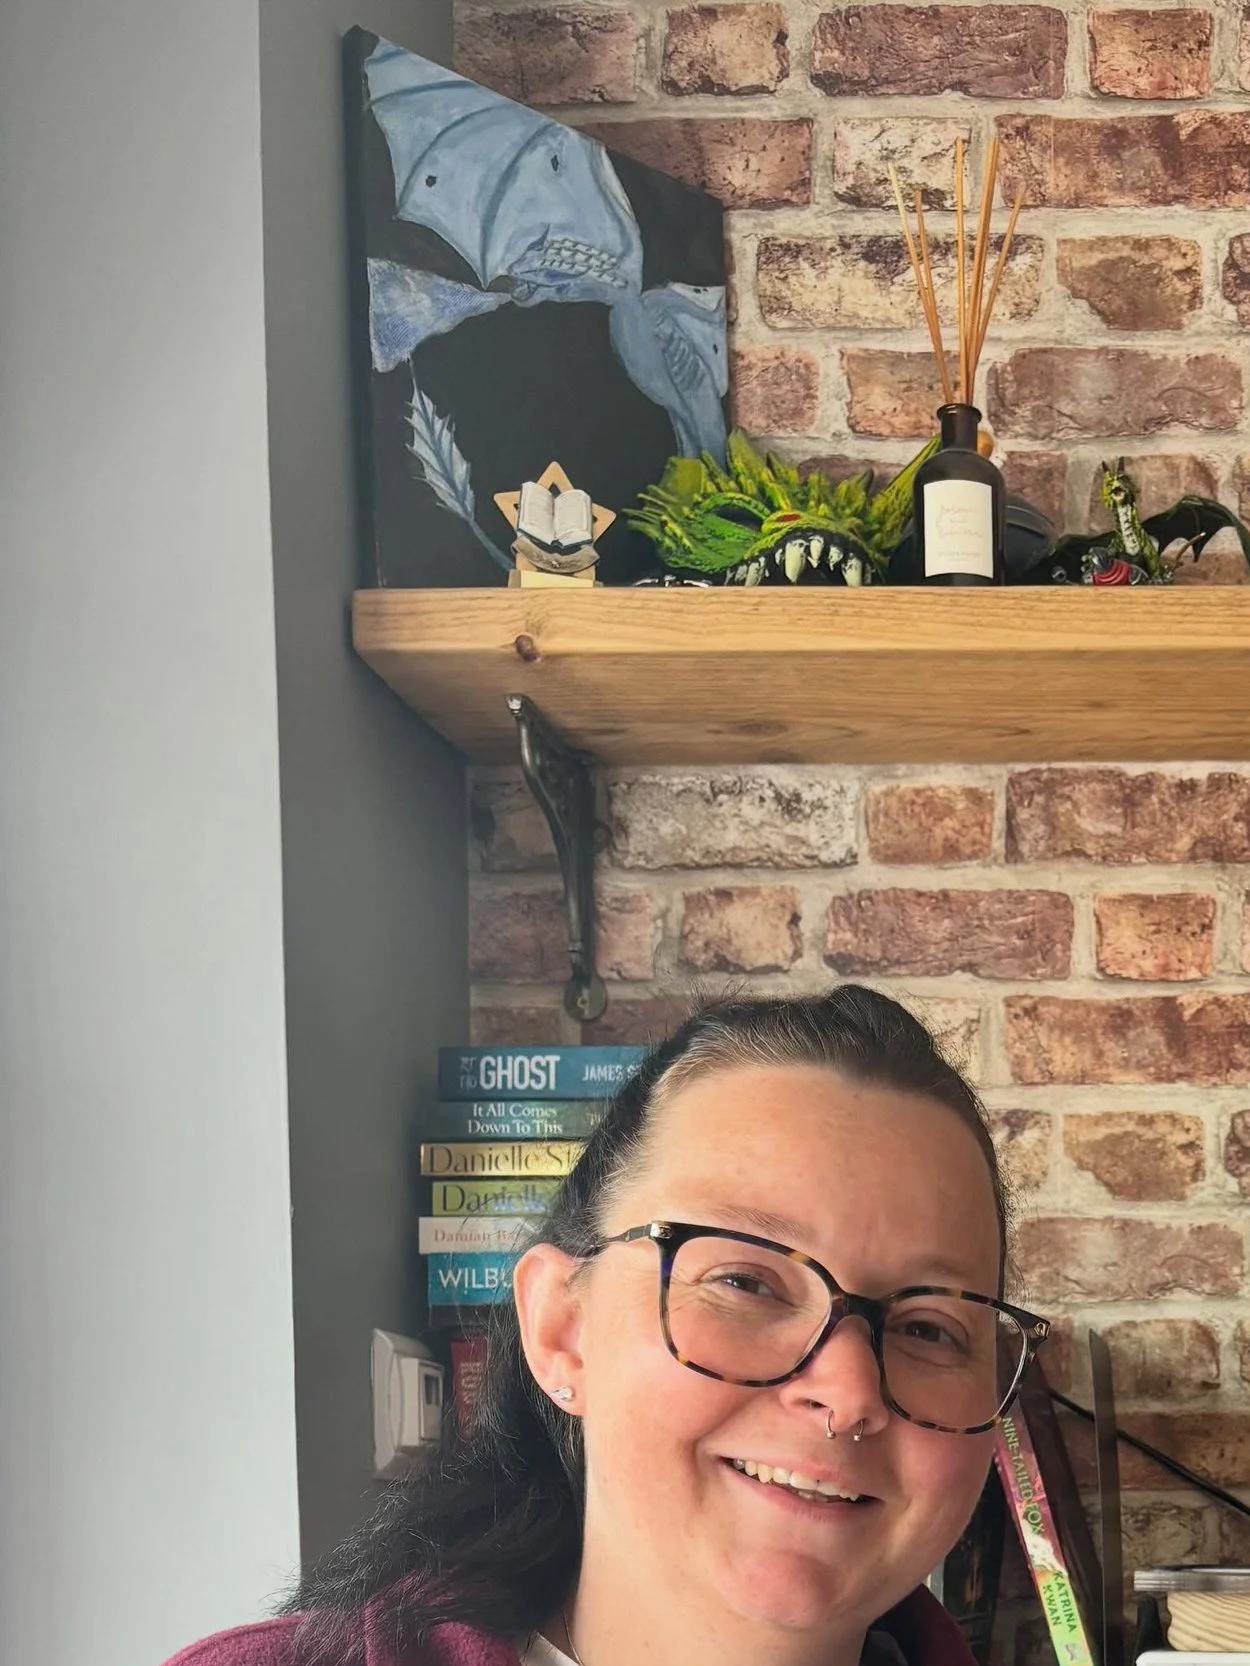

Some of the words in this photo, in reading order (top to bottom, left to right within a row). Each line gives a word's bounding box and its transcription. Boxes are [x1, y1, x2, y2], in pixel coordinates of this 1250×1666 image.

[480, 1055, 561, 1090] GHOST
[582, 1064, 624, 1082] JAMES
[468, 1120, 510, 1134] Down
[512, 1119, 531, 1134] To
[532, 1119, 563, 1134] This
[473, 1104, 487, 1117] It
[488, 1104, 505, 1117] All
[509, 1104, 557, 1118] Comes
[429, 1145, 540, 1173] Danielle
[1002, 1417, 1034, 1500] NINE-TAILED
[1023, 1503, 1045, 1536] FOX
[1042, 1583, 1062, 1627] KWAN
[1053, 1571, 1078, 1633] KATRINA
